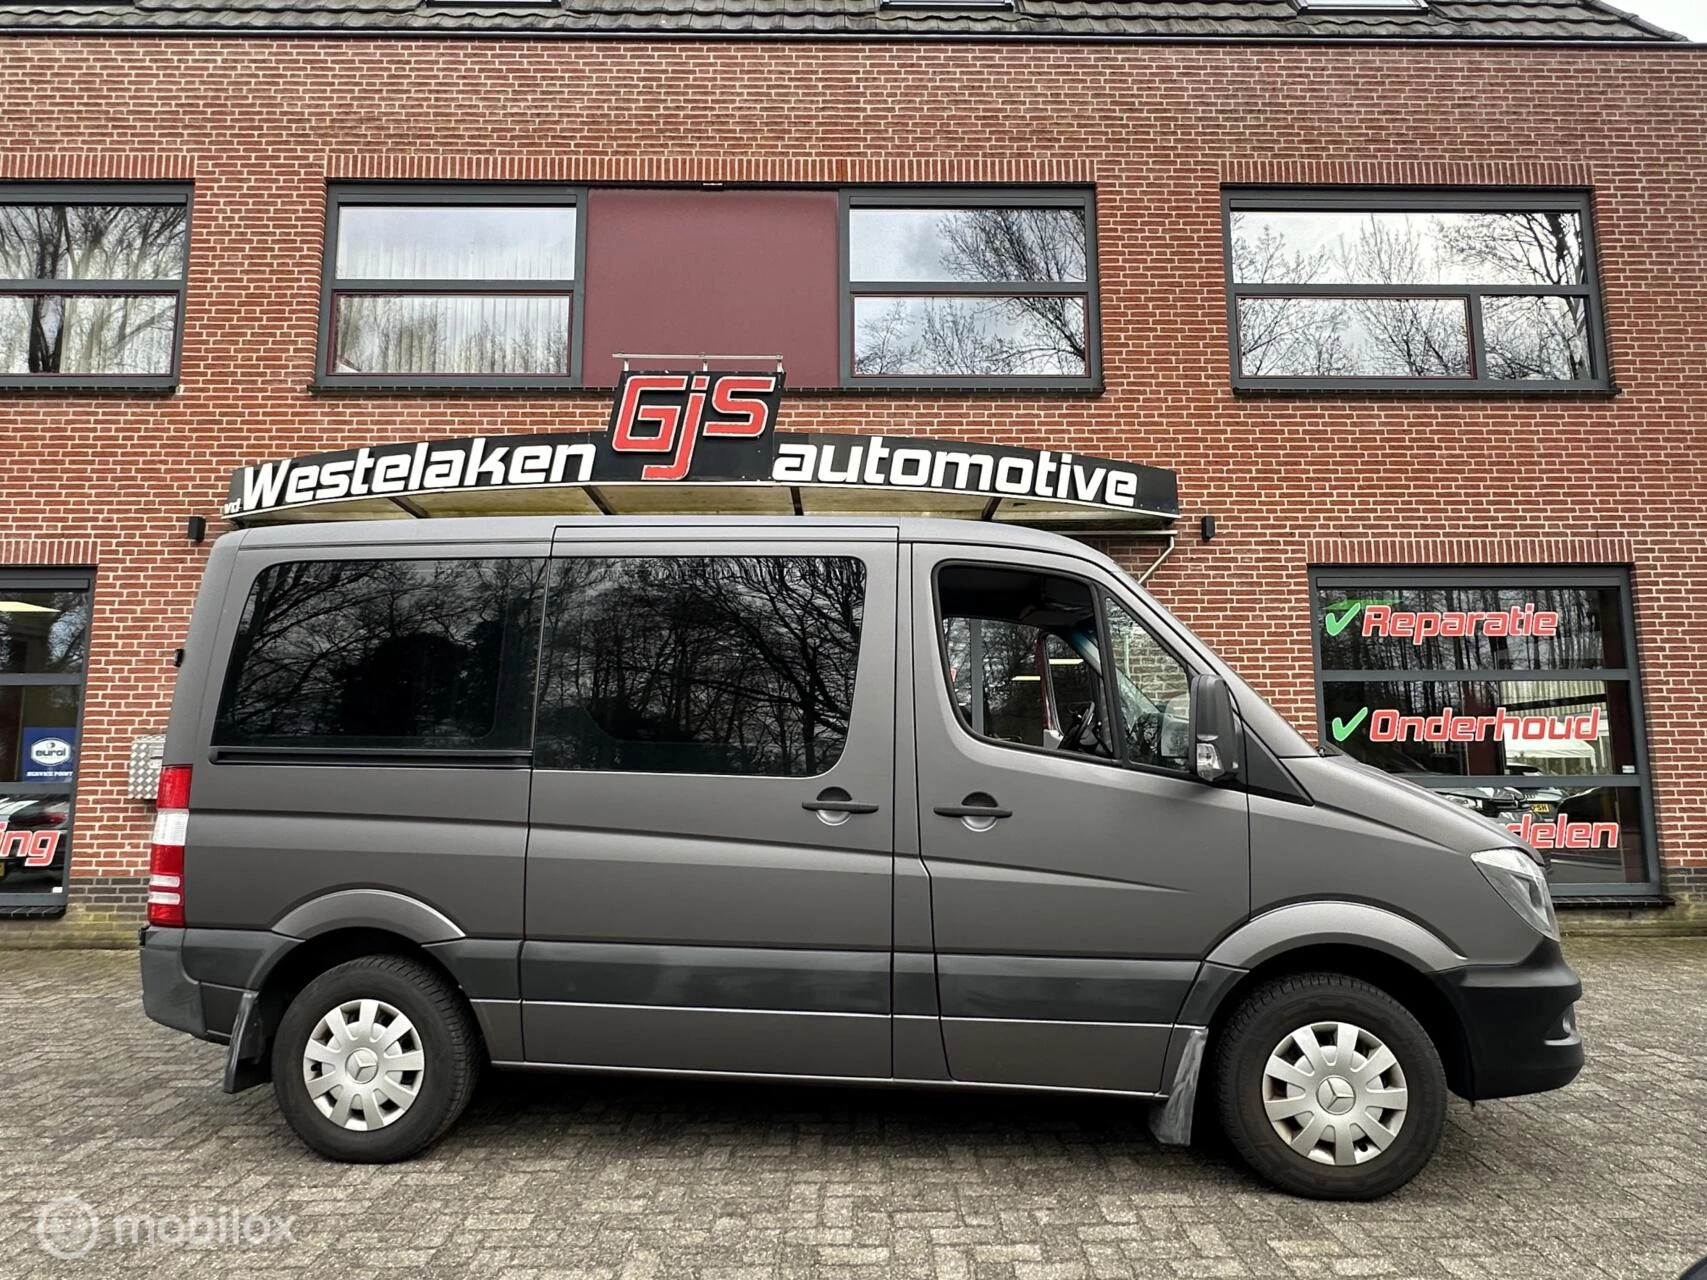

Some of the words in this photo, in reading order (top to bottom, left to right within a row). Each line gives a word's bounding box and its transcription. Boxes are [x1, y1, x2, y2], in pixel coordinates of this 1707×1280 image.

[242, 438, 595, 510] Westelaken
[773, 436, 1138, 506] automotive
[1362, 604, 1558, 646] Reparatie
[1369, 708, 1601, 742] Onderhoud
[35, 748, 66, 757] eurol
[1502, 813, 1620, 848] delen
